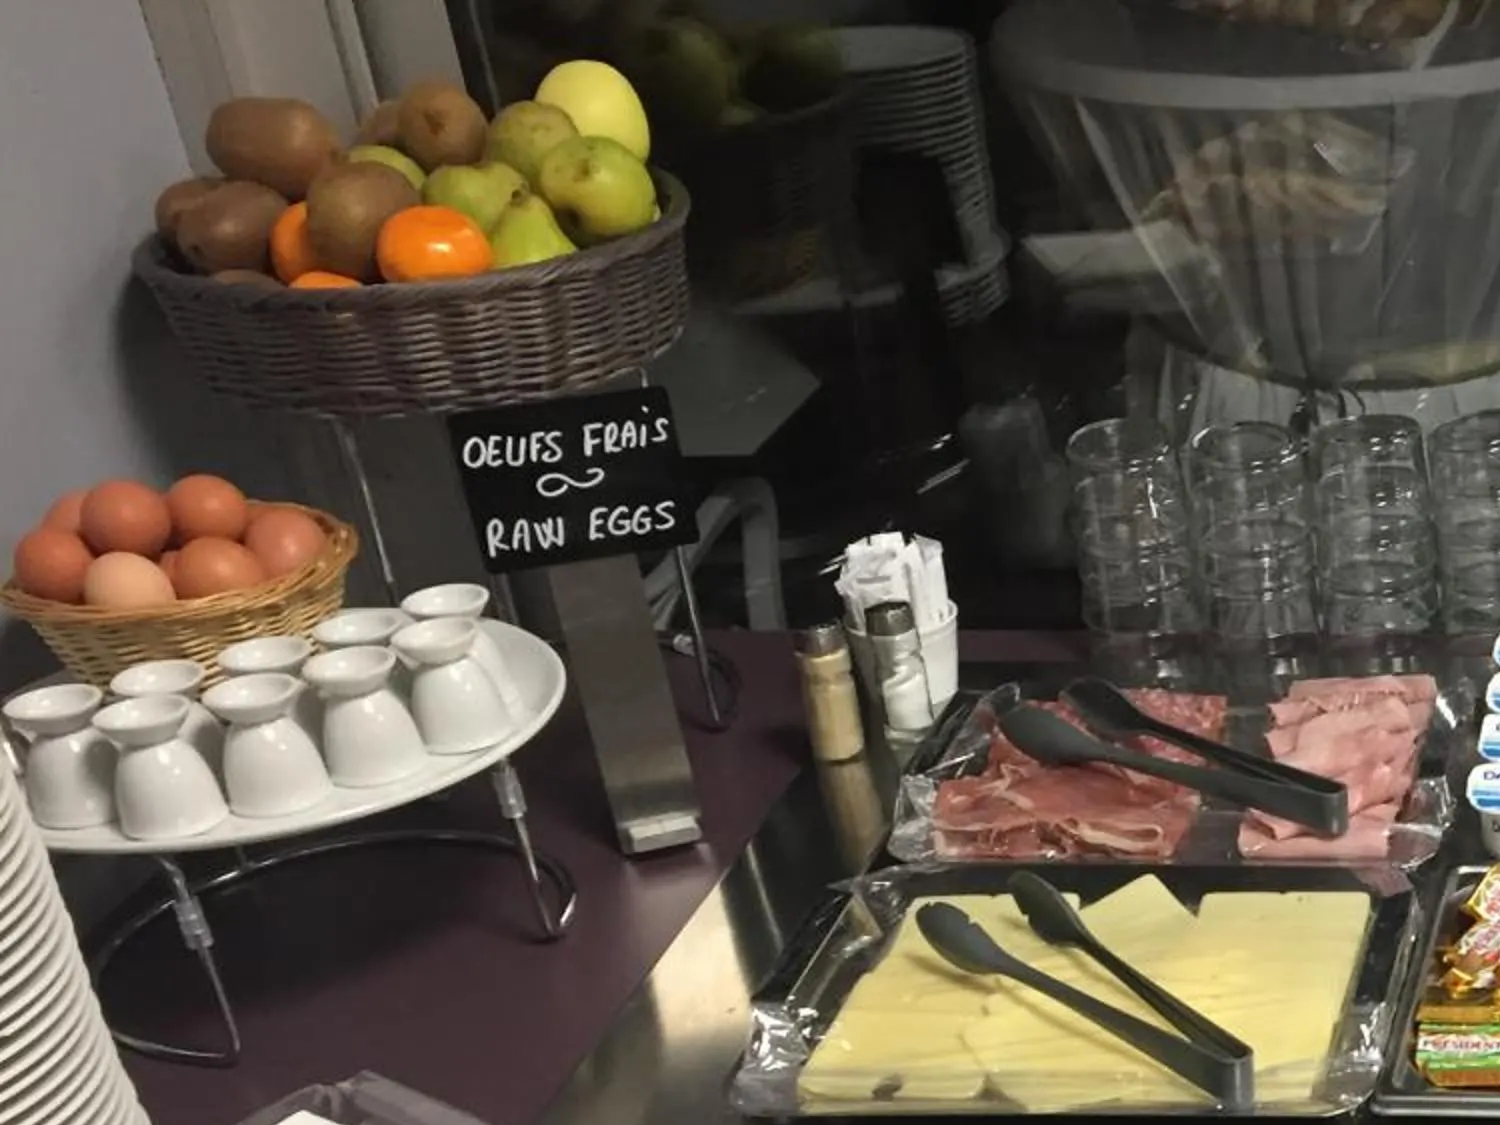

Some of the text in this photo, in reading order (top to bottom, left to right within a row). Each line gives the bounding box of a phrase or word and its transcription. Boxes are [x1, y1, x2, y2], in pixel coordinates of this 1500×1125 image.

[463, 431, 563, 468] OEUFS
[486, 501, 676, 558] RAW EGGS
